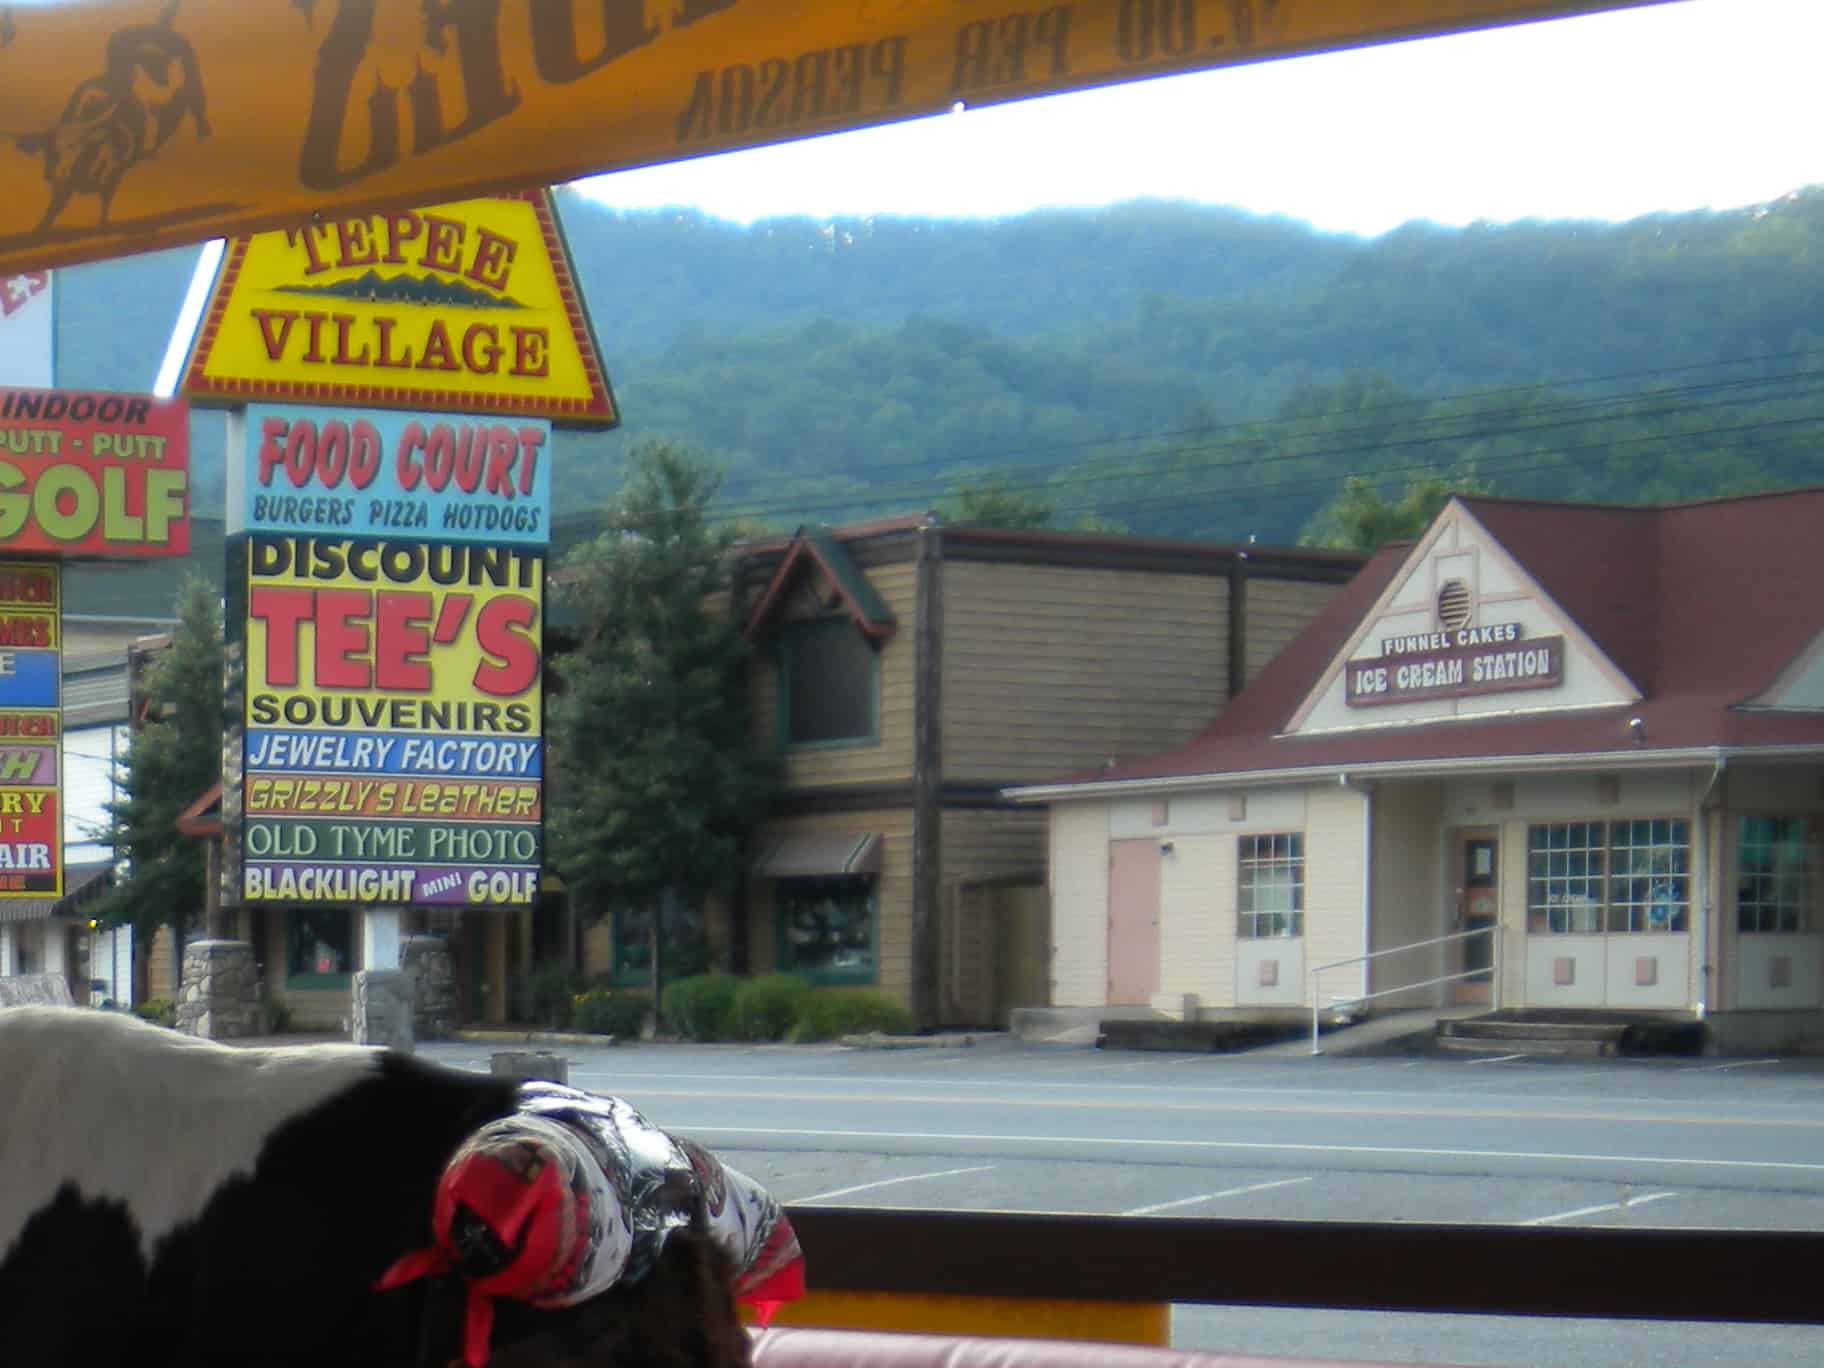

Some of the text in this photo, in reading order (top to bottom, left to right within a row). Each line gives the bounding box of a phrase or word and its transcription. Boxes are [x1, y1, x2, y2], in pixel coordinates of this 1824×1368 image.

[285, 210, 518, 292] TEPEE
[251, 308, 551, 378] VILLAGE
[1, 392, 151, 425] INDOOR
[257, 416, 546, 498] FOOD COURT
[253, 495, 542, 534] BURGERS PIZZA HOTDOGS
[250, 537, 538, 589] DISCOUNT
[249, 583, 540, 698] TEE'S
[1383, 623, 1517, 655] FUNNEL CAKES
[1355, 648, 1551, 695] ICE CREAM STATION
[252, 694, 532, 732] SOUVENIRS
[249, 735, 538, 773] JEWELRY FACTORY
[247, 824, 537, 860] OLD TYME PHOTO
[245, 867, 538, 904] BLACKLIGHT MINI GOLF
